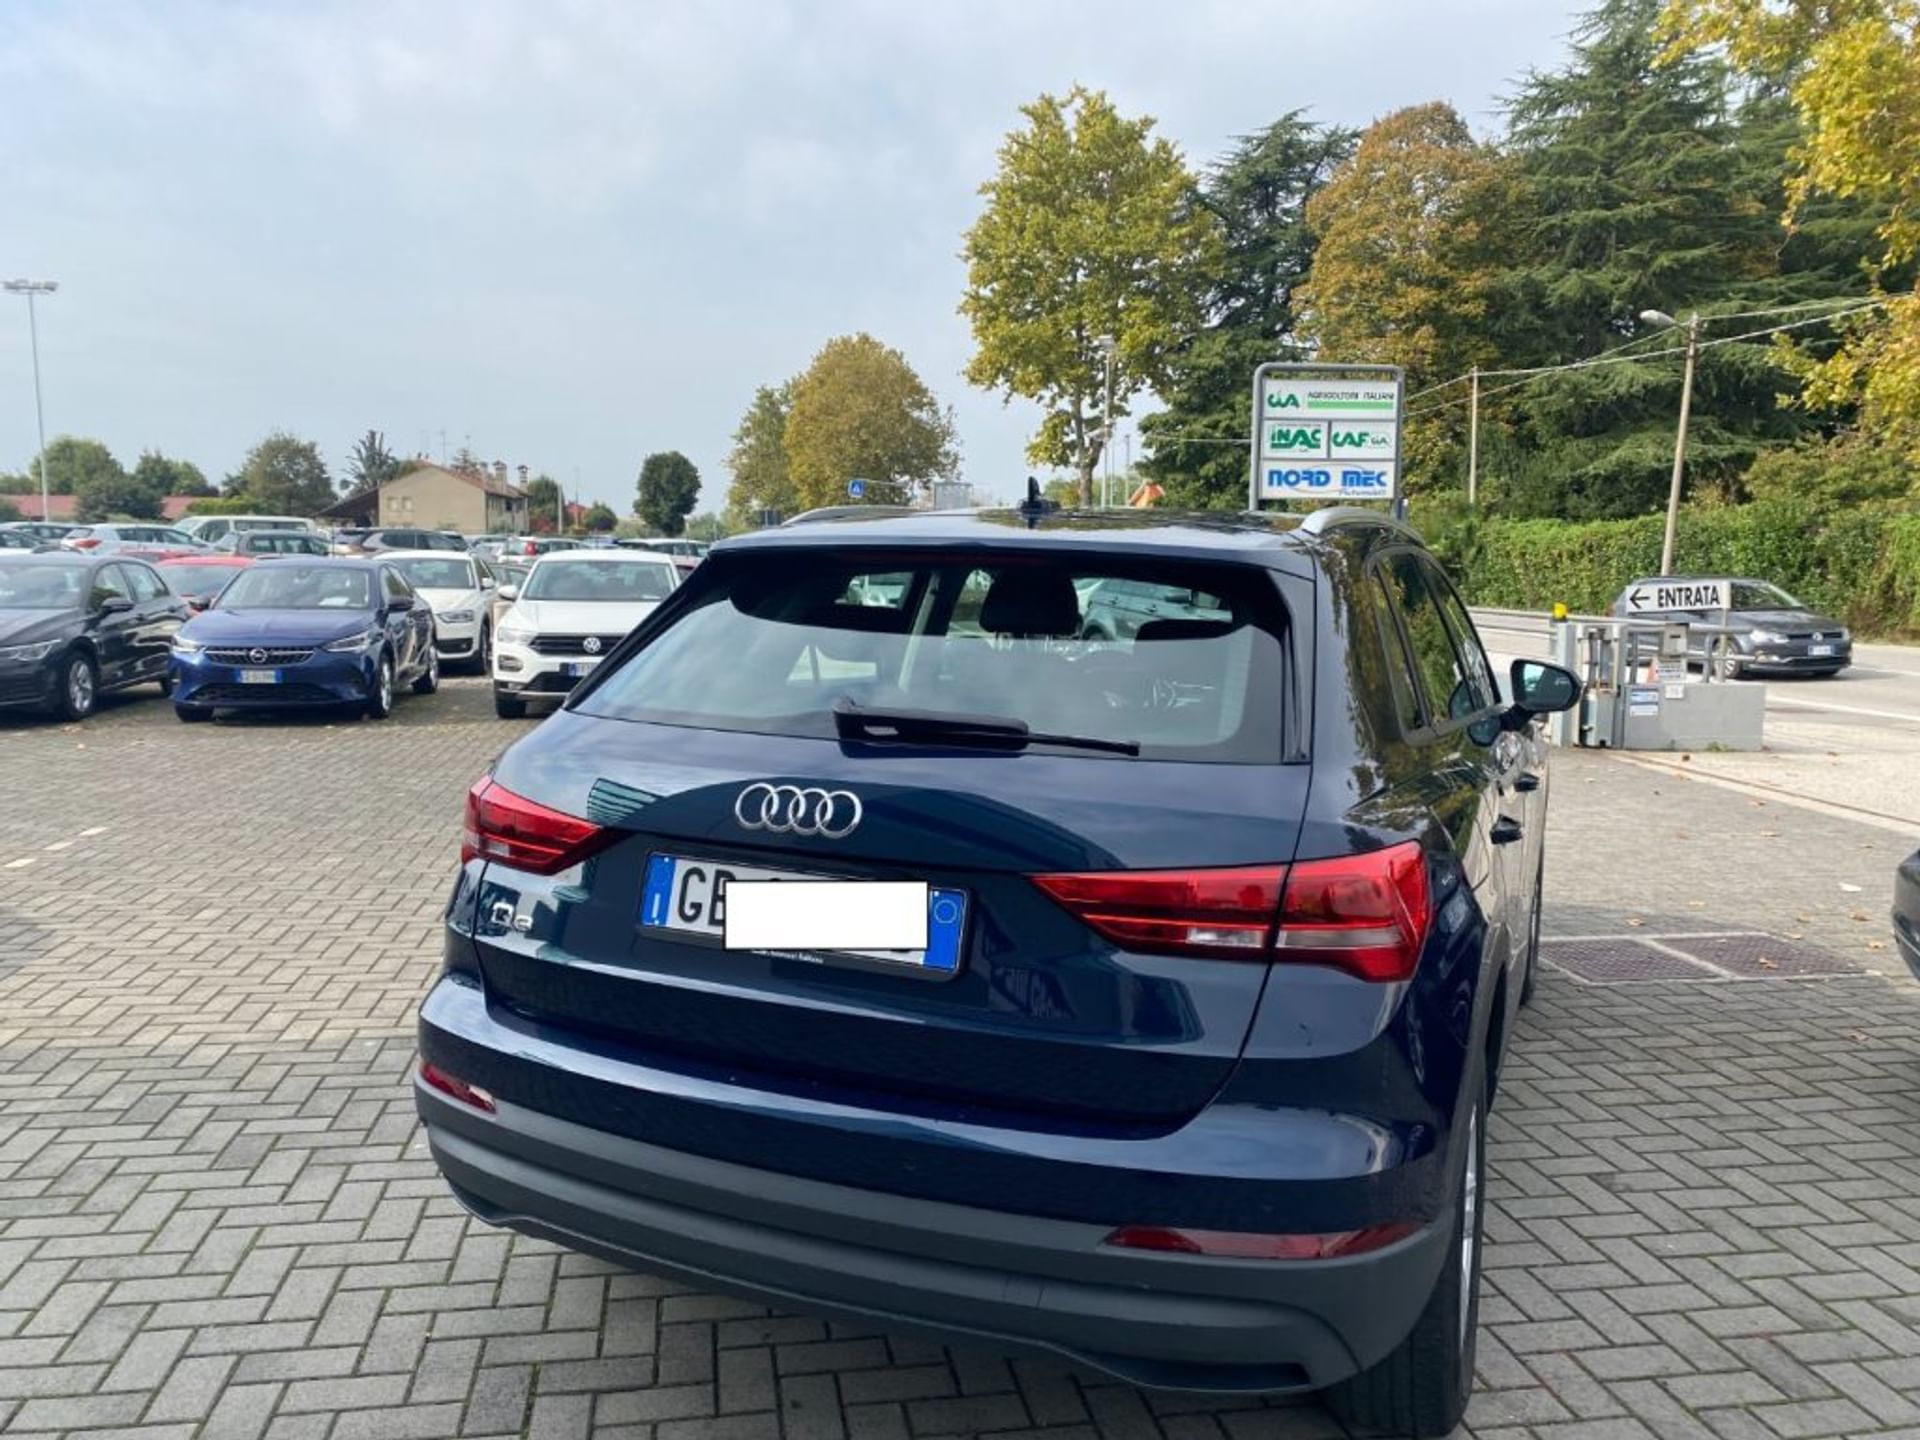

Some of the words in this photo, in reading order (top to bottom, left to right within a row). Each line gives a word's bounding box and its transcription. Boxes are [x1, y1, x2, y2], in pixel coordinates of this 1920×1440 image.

[1268, 469, 1330, 487] NORD
[1341, 470, 1387, 487] MEC
[1657, 584, 1721, 608] ENTRATA
